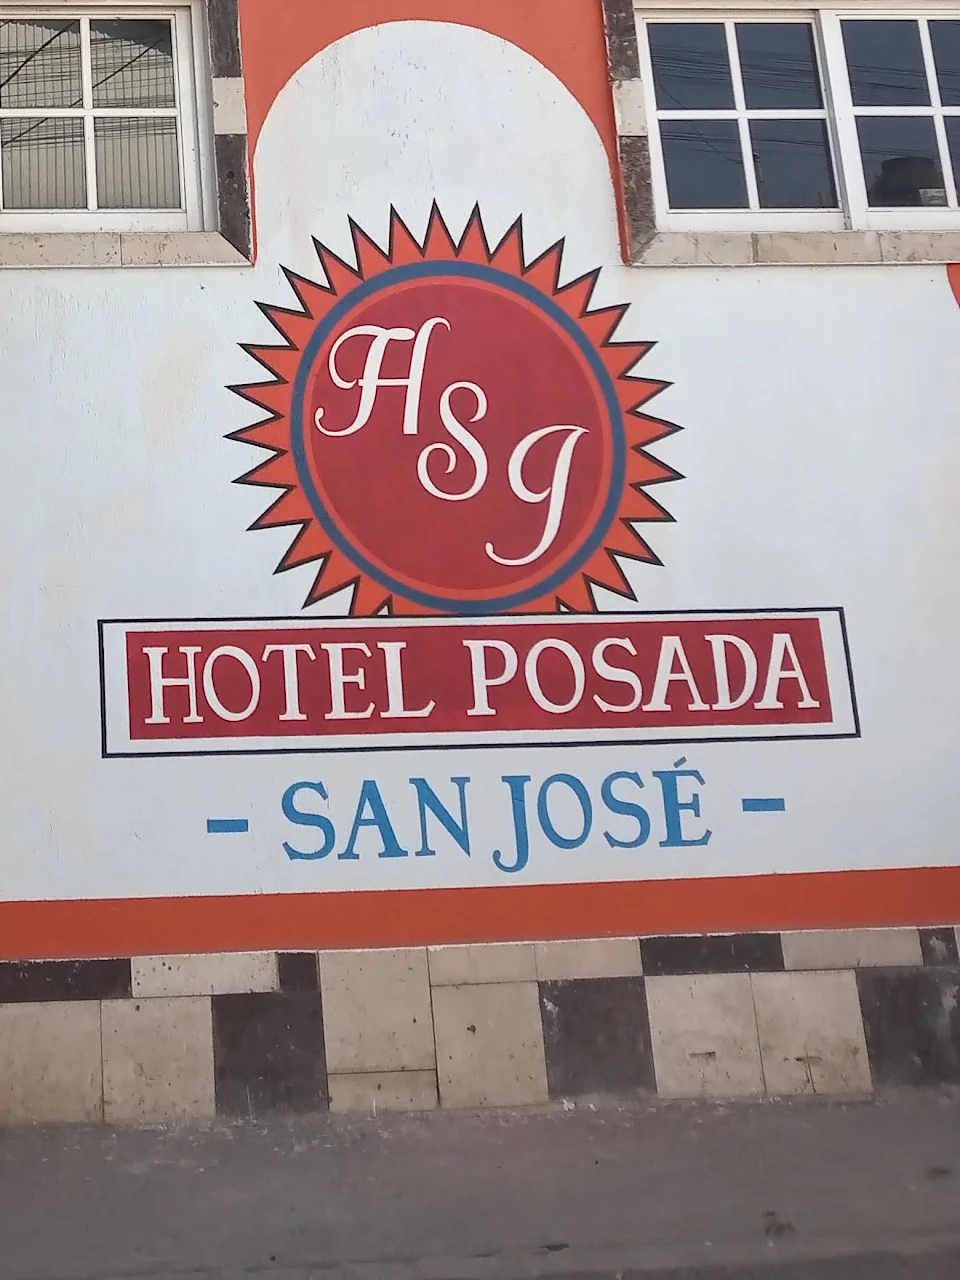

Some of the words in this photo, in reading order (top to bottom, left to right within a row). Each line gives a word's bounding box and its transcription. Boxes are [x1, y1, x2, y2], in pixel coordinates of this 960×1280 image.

[142, 641, 436, 724] HOTEL
[462, 632, 821, 716] POSADA
[281, 776, 471, 861] SAN
[492, 757, 713, 874] JOSÉ
